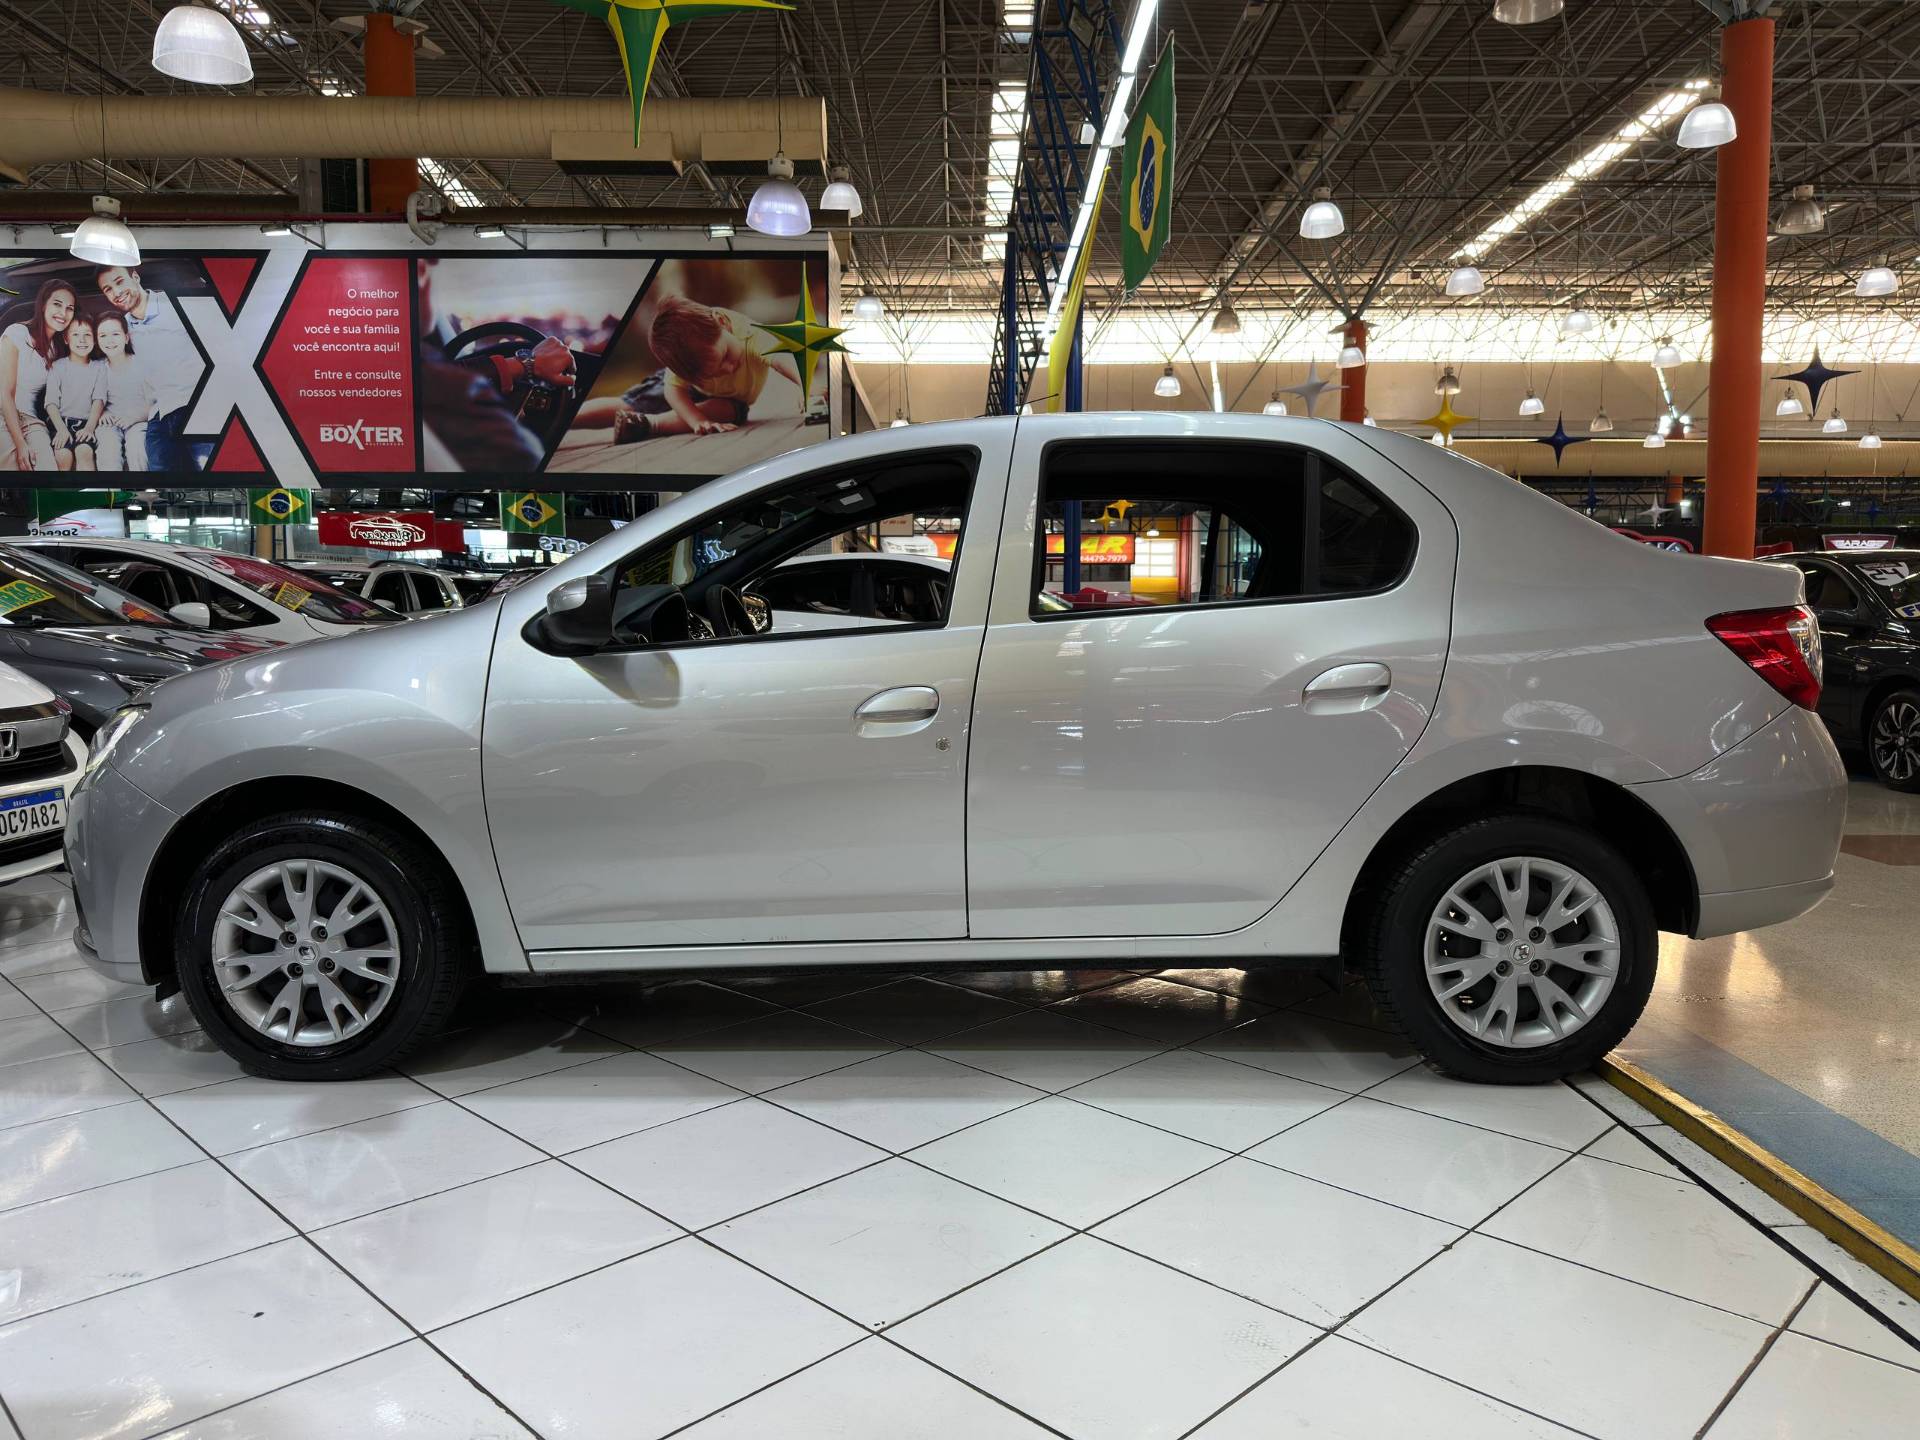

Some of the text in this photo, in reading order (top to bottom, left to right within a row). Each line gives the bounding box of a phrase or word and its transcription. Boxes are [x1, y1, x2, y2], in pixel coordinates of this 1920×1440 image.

[347, 288, 399, 299] O melhor
[328, 306, 399, 318] negócio para
[304, 324, 400, 334] você e sua família
[293, 341, 400, 354] você encontra aqui!
[314, 369, 401, 380] Entre e consulte
[299, 388, 402, 397] nossos vendedores
[320, 419, 404, 450] BOXTER
